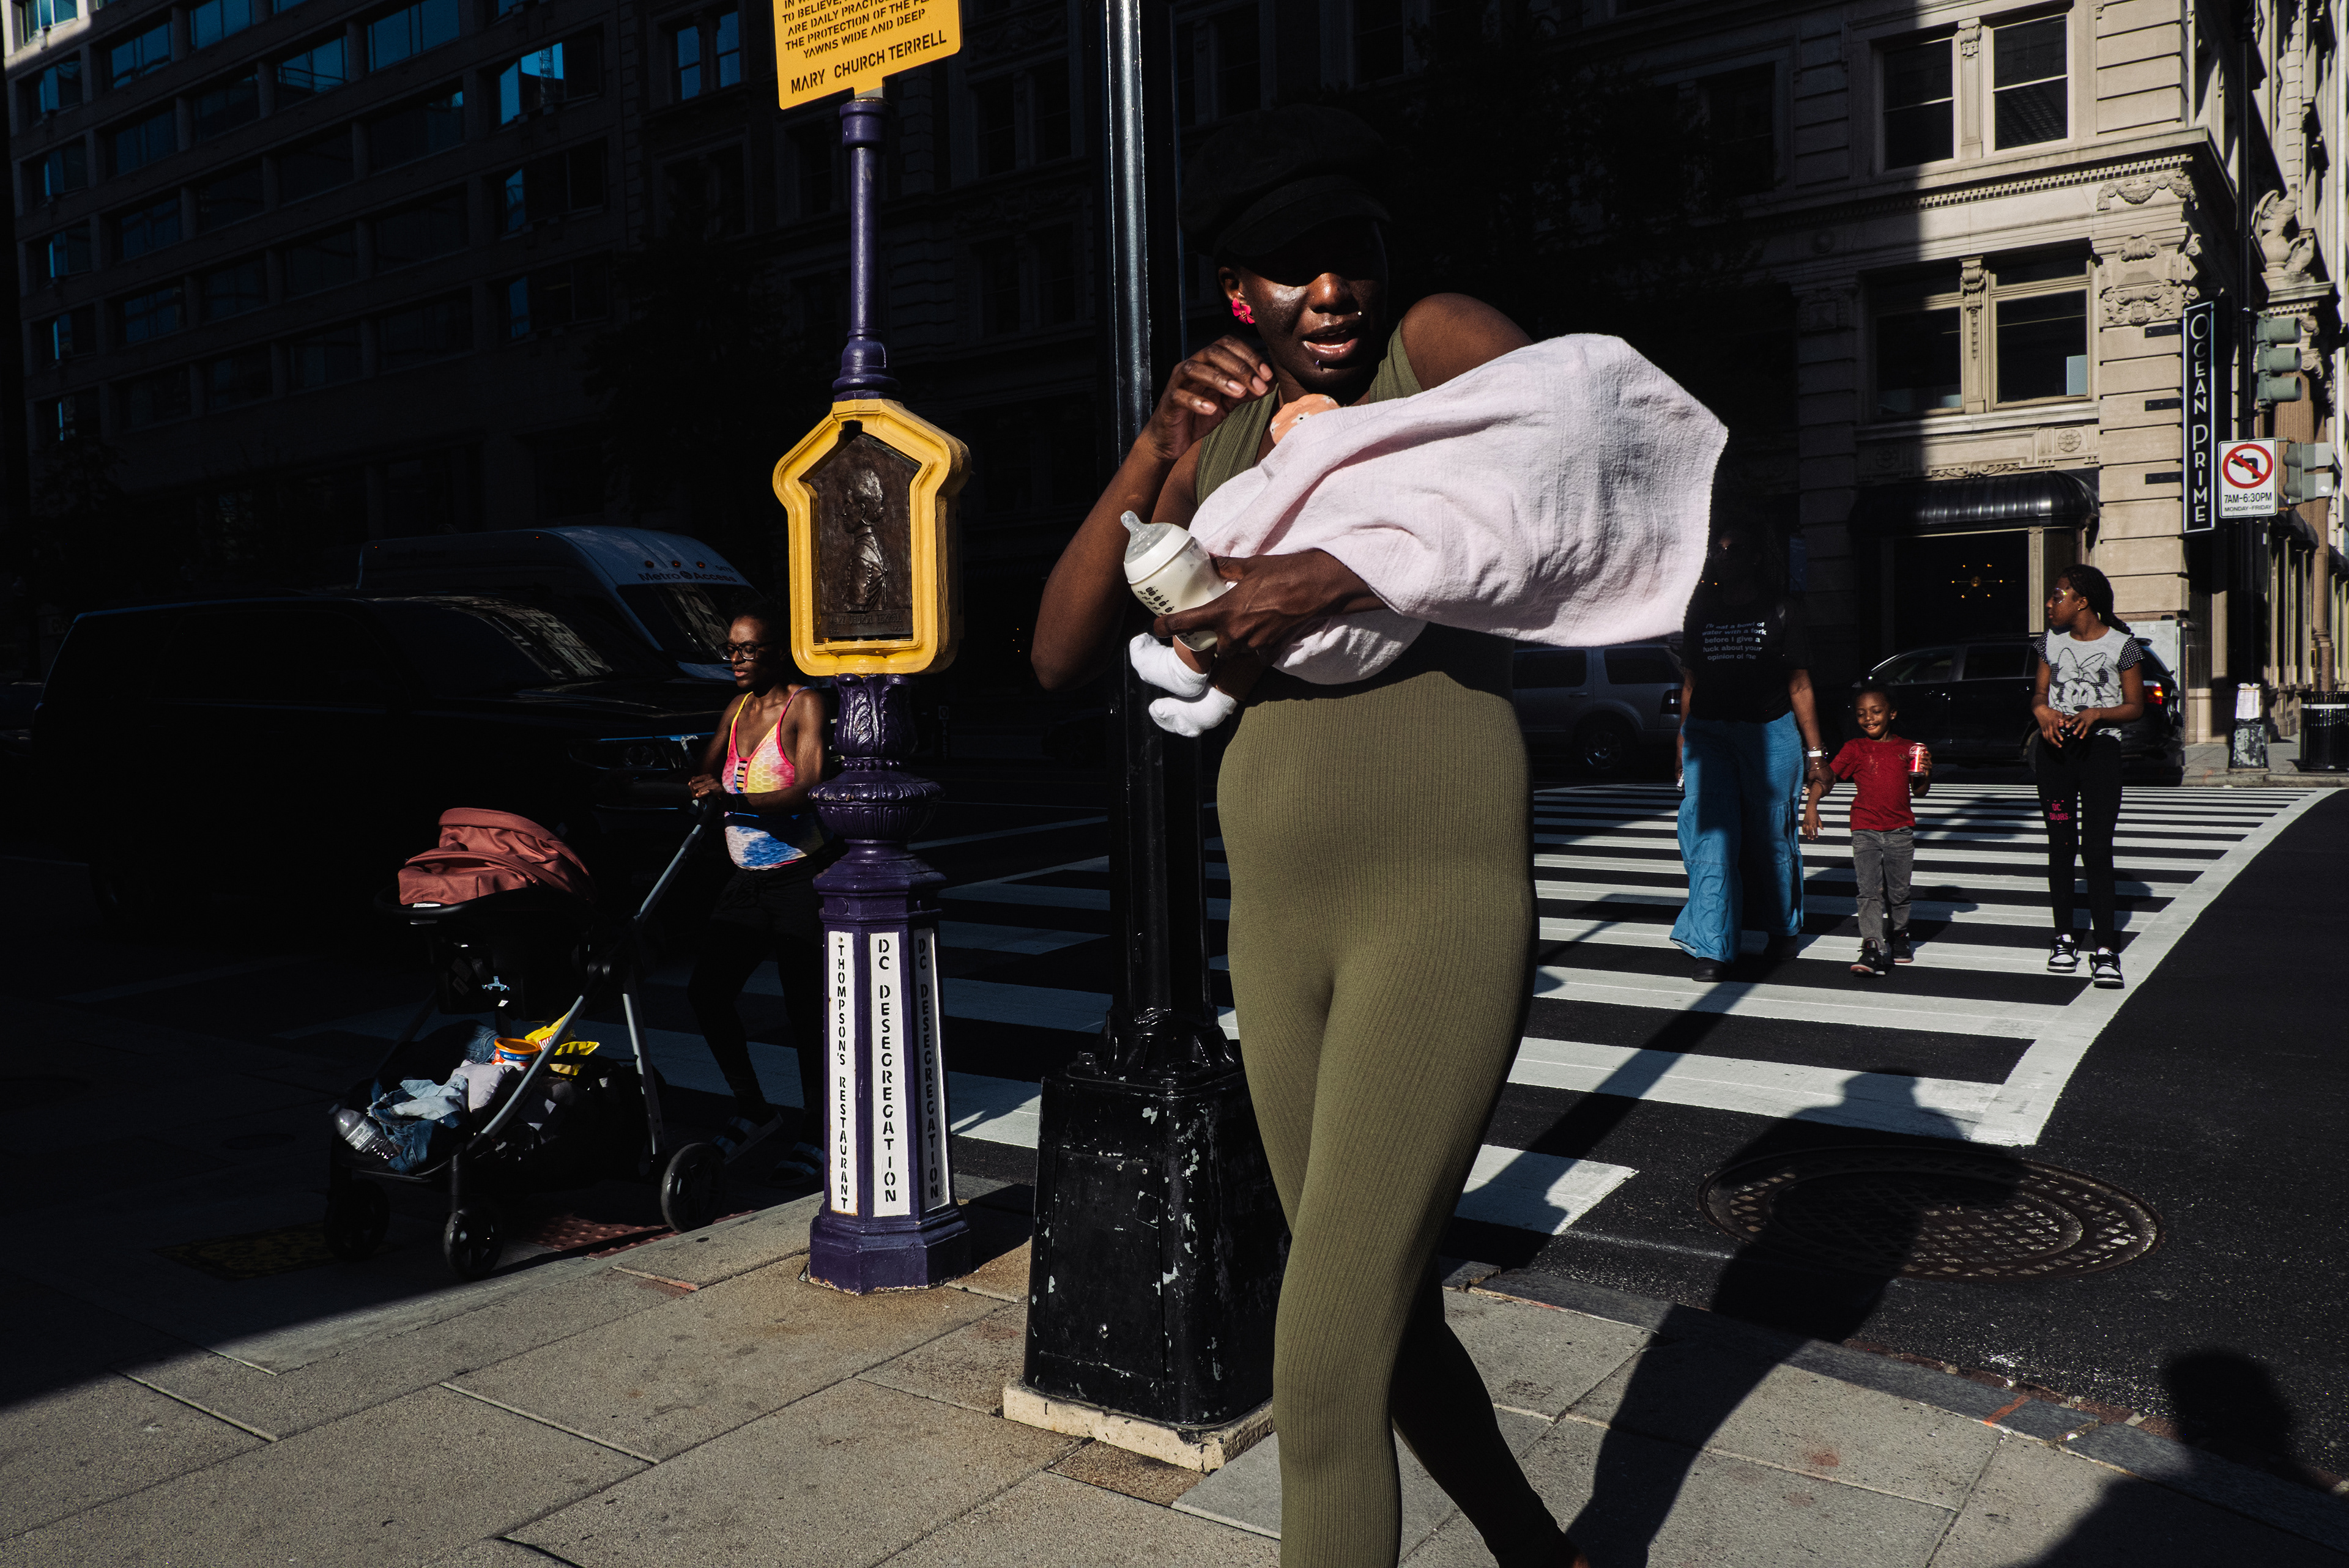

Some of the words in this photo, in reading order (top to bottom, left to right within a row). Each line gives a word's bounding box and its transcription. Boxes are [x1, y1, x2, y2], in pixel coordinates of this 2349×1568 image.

[782, 12, 794, 23] TO
[785, 37, 805, 50] THE
[807, 13, 869, 43] PROTECTION
[874, 7, 886, 20] OF
[889, 0, 910, 13] THE
[788, 21, 807, 37] ARE
[811, 10, 838, 28] DAILY
[804, 39, 838, 59] YAWNS
[841, 28, 867, 45] WIDE
[871, 20, 893, 35] AND
[897, 9, 925, 26] DEEP
[791, 68, 825, 94] MARY
[834, 49, 885, 78] CHURCH
[888, 30, 947, 60] TERRELL
[2190, 314, 2210, 415] OCEAN
[2192, 424, 2208, 522] PRIME
[2224, 492, 2272, 503] 7AM-6:30PM
[638, 572, 680, 581] Metro
[694, 572, 737, 582] Access
[878, 939, 890, 970] DC
[918, 937, 927, 970] DC
[837, 944, 847, 1065] THOMPSON'S
[879, 985, 897, 1202] DESEGREGATION
[920, 983, 939, 1200] DESEGREGATION
[839, 1076, 848, 1210] RESTAURANT
